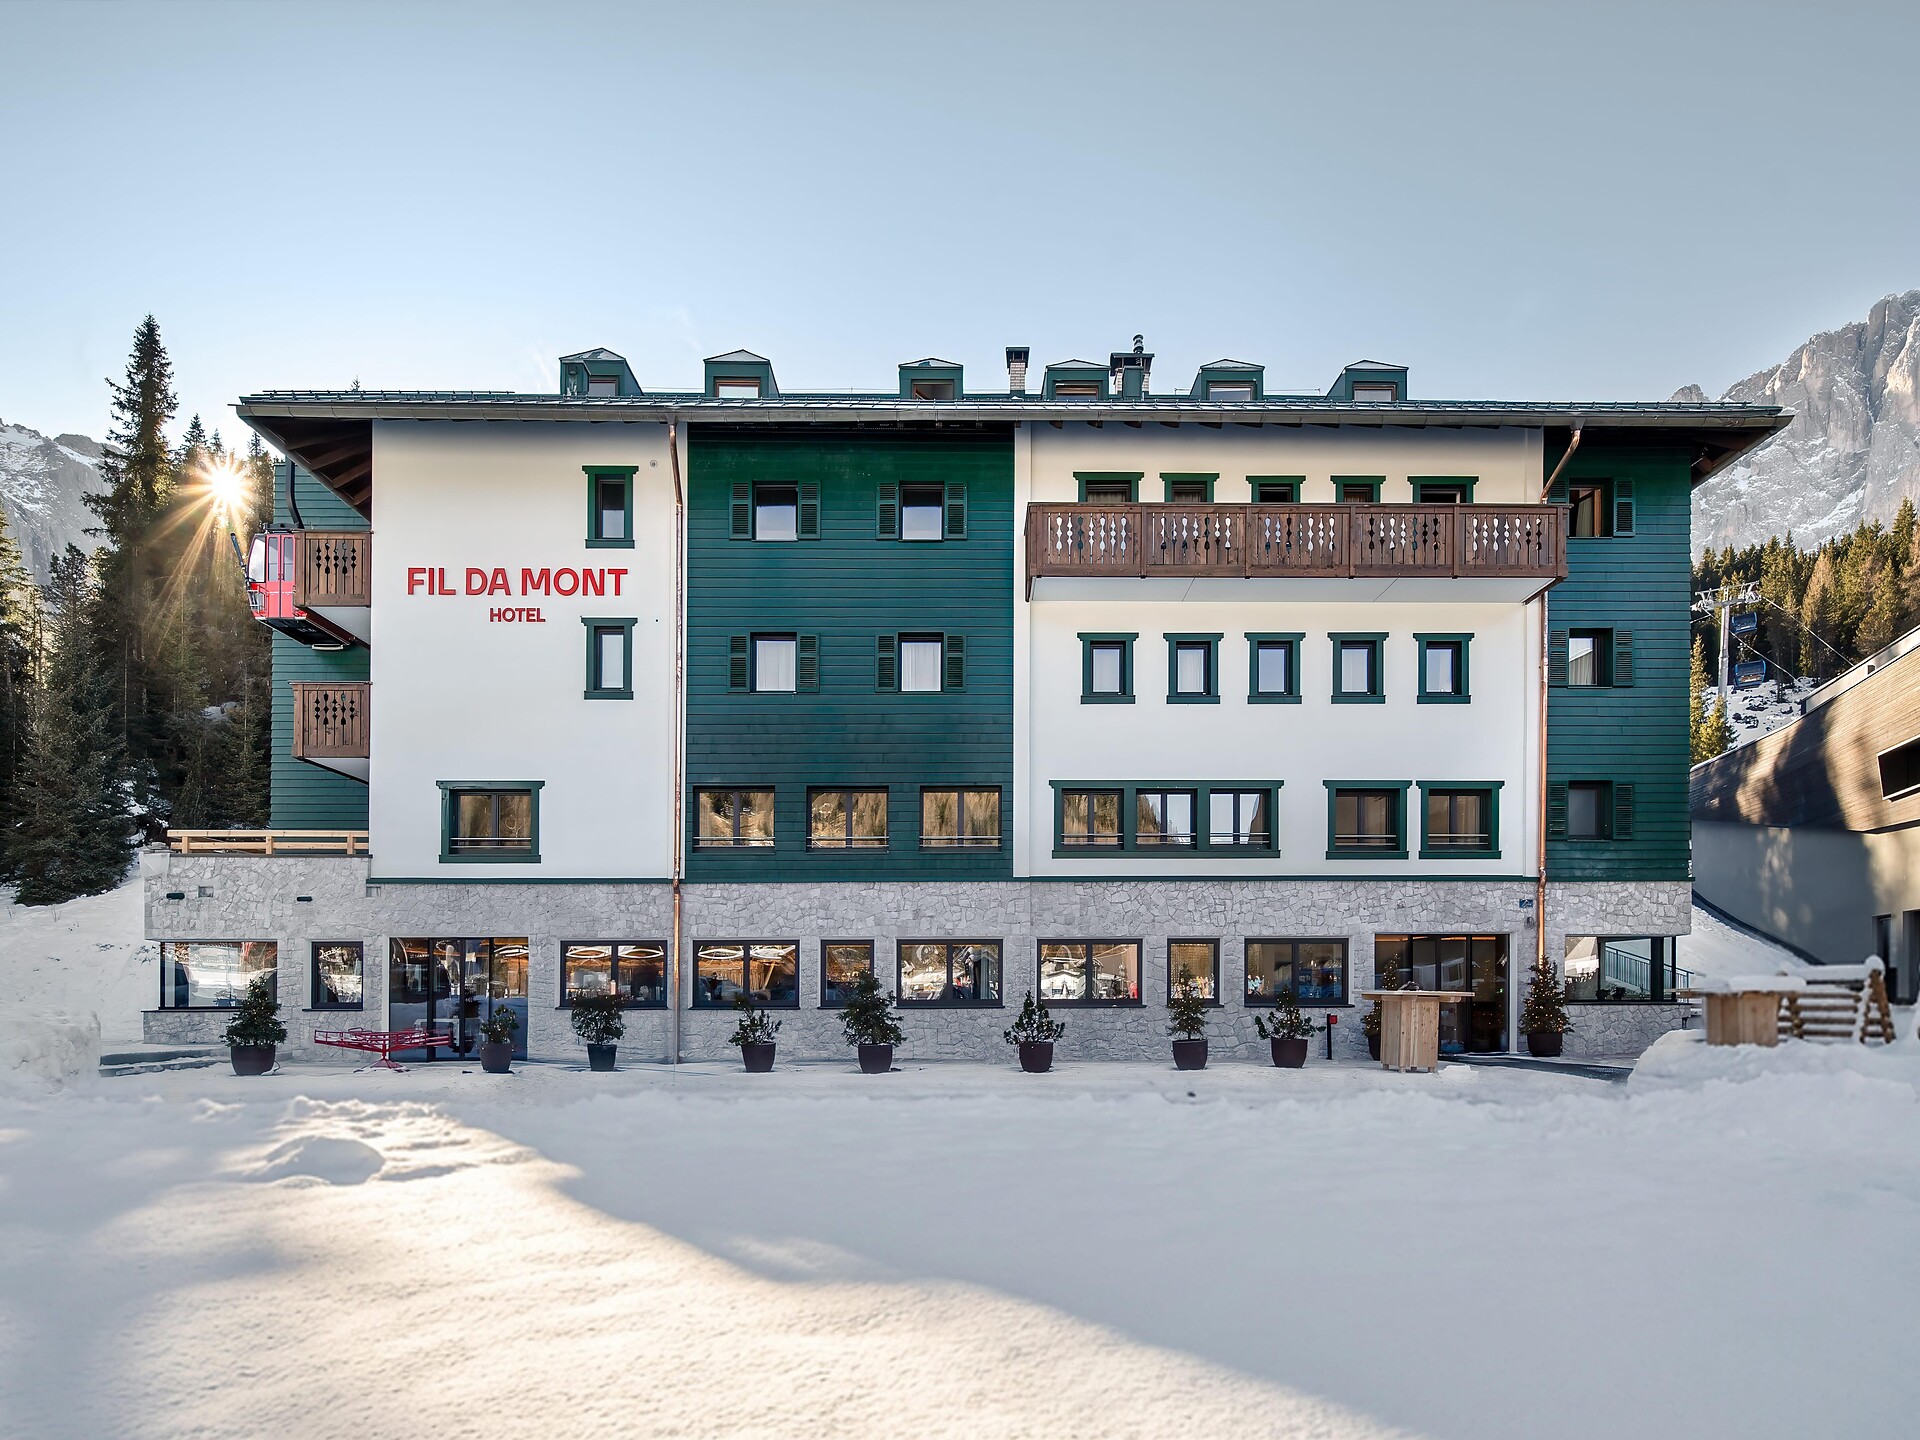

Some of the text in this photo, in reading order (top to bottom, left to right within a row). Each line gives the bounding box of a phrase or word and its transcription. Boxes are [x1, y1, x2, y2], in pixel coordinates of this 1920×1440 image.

[407, 567, 628, 596] FIL DA MONT
[489, 607, 545, 623] HOTEL
